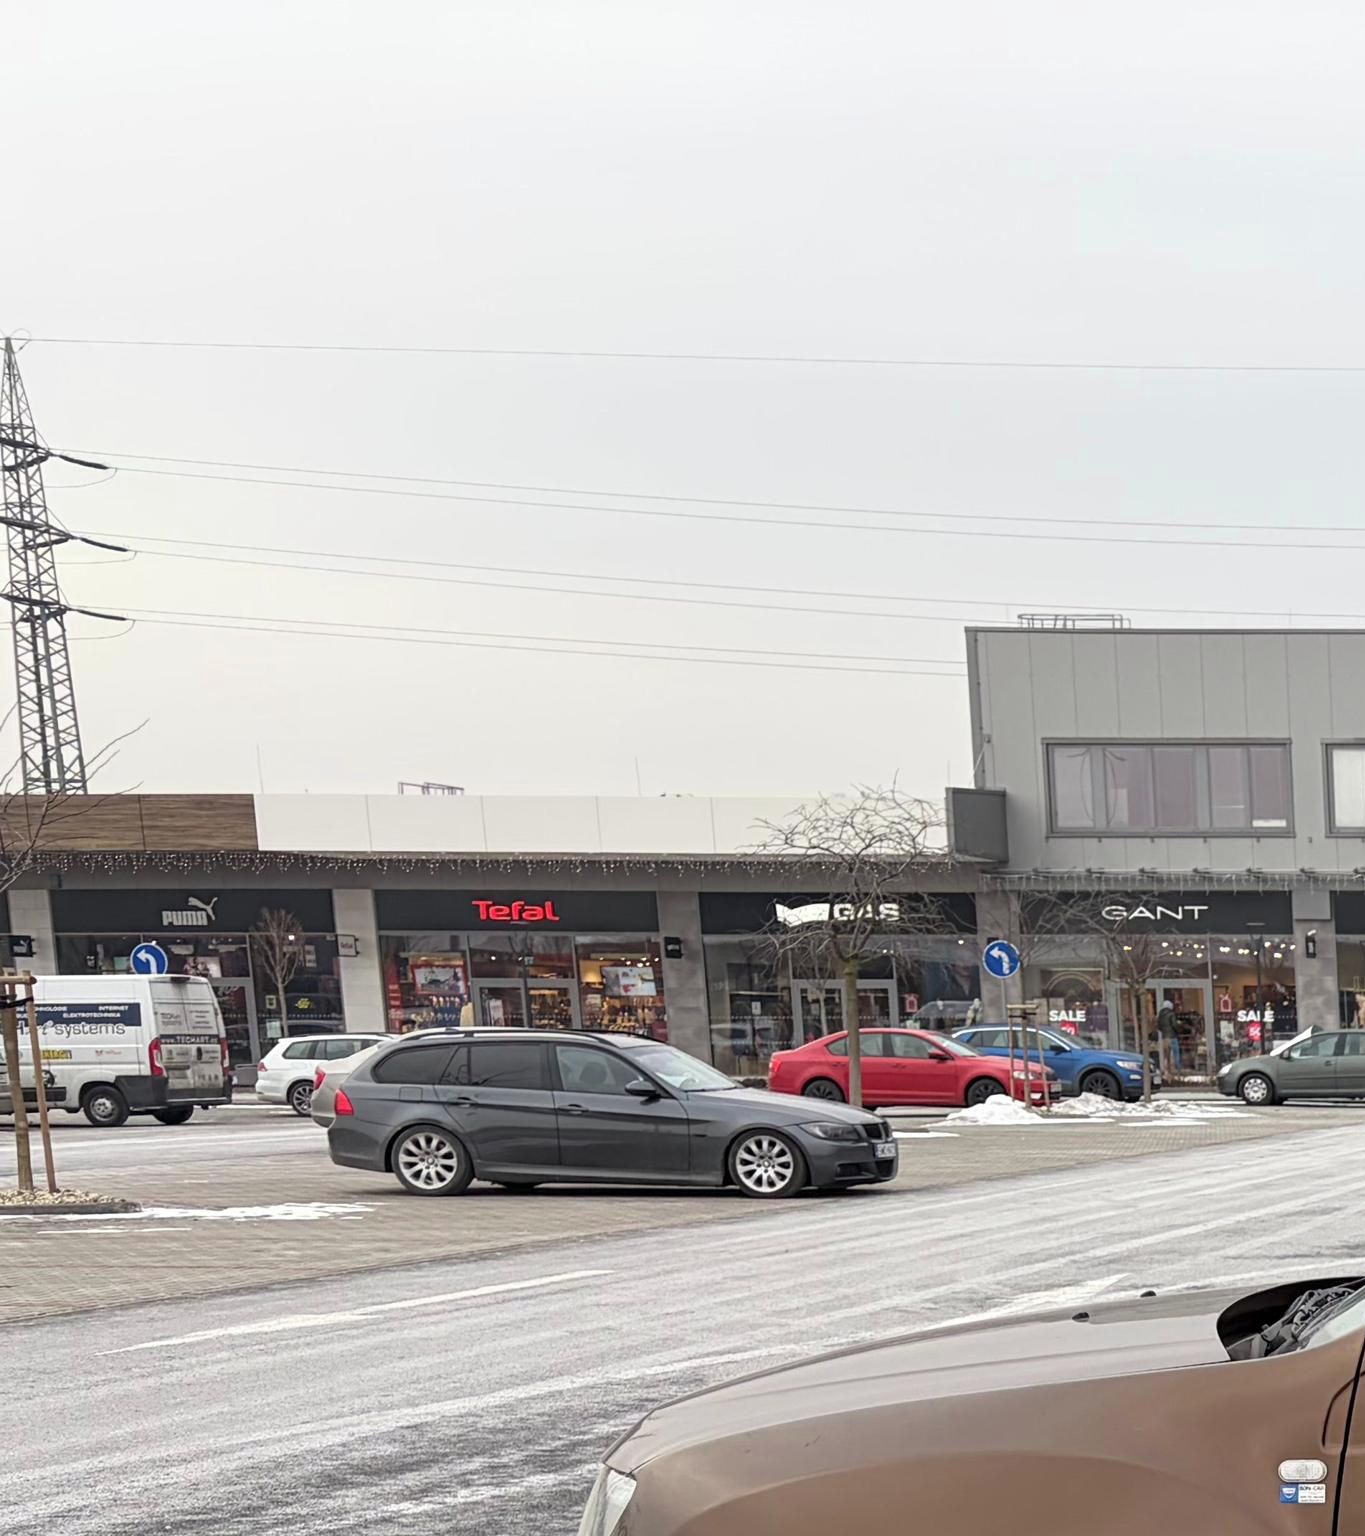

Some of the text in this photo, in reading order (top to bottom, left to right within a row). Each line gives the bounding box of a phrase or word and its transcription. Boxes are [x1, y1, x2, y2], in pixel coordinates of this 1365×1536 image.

[162, 911, 208, 926] PUMA
[472, 900, 560, 922] Tefal
[833, 903, 900, 921] GAS
[1101, 905, 1208, 921] GANT
[1049, 1009, 1086, 1021] SALE
[54, 1022, 126, 1038] systems
